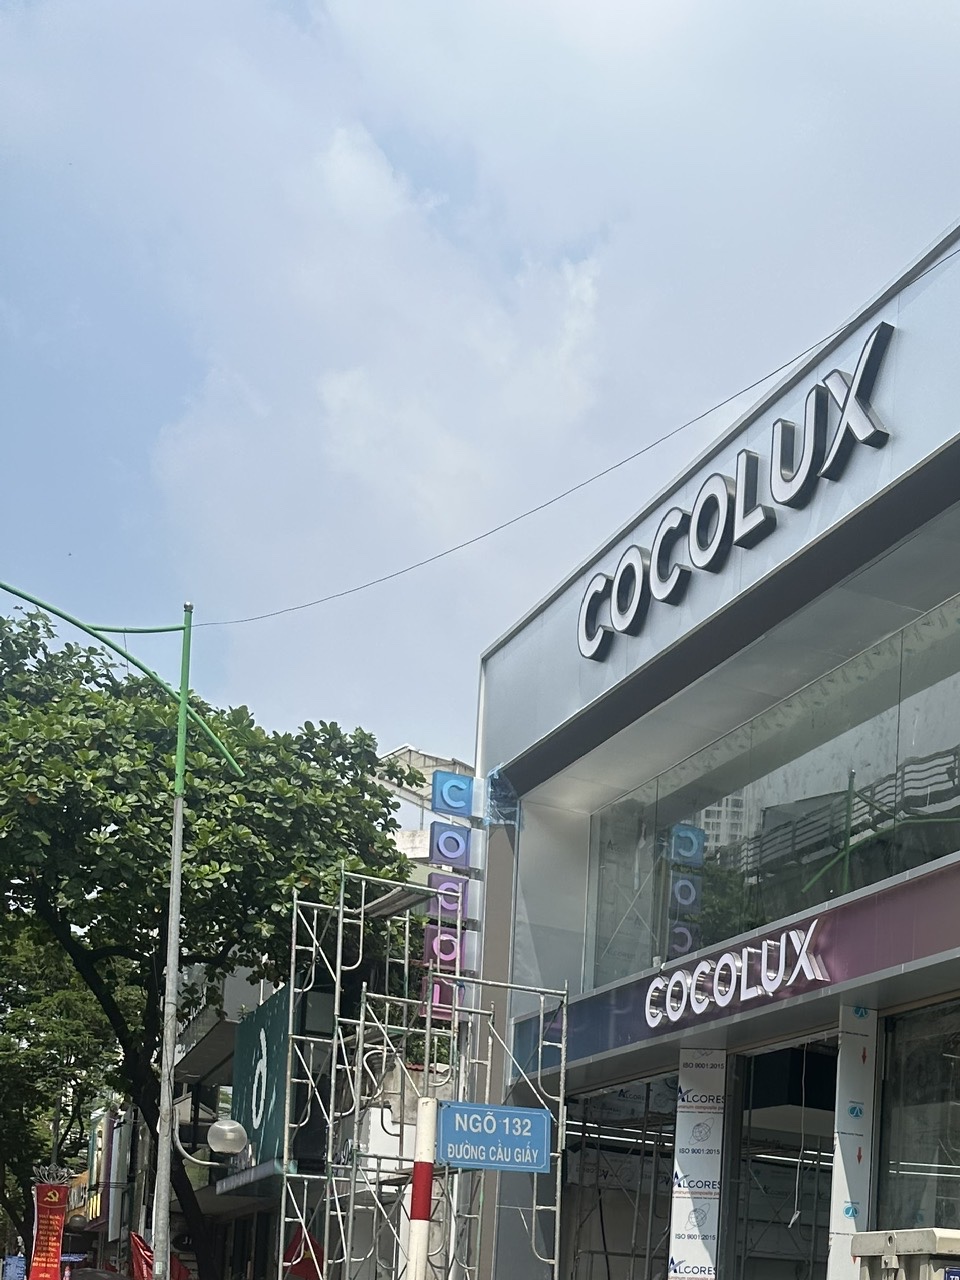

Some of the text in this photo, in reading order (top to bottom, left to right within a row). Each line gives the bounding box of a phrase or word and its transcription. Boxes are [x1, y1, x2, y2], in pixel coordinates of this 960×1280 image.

[577, 321, 894, 663] COCOLUX
[645, 919, 830, 1028] COCOLUX
[447, 1139, 538, 1163] ĐƯỜNG CẦU GIẤY
[455, 1112, 532, 1137] NGÕ 132
